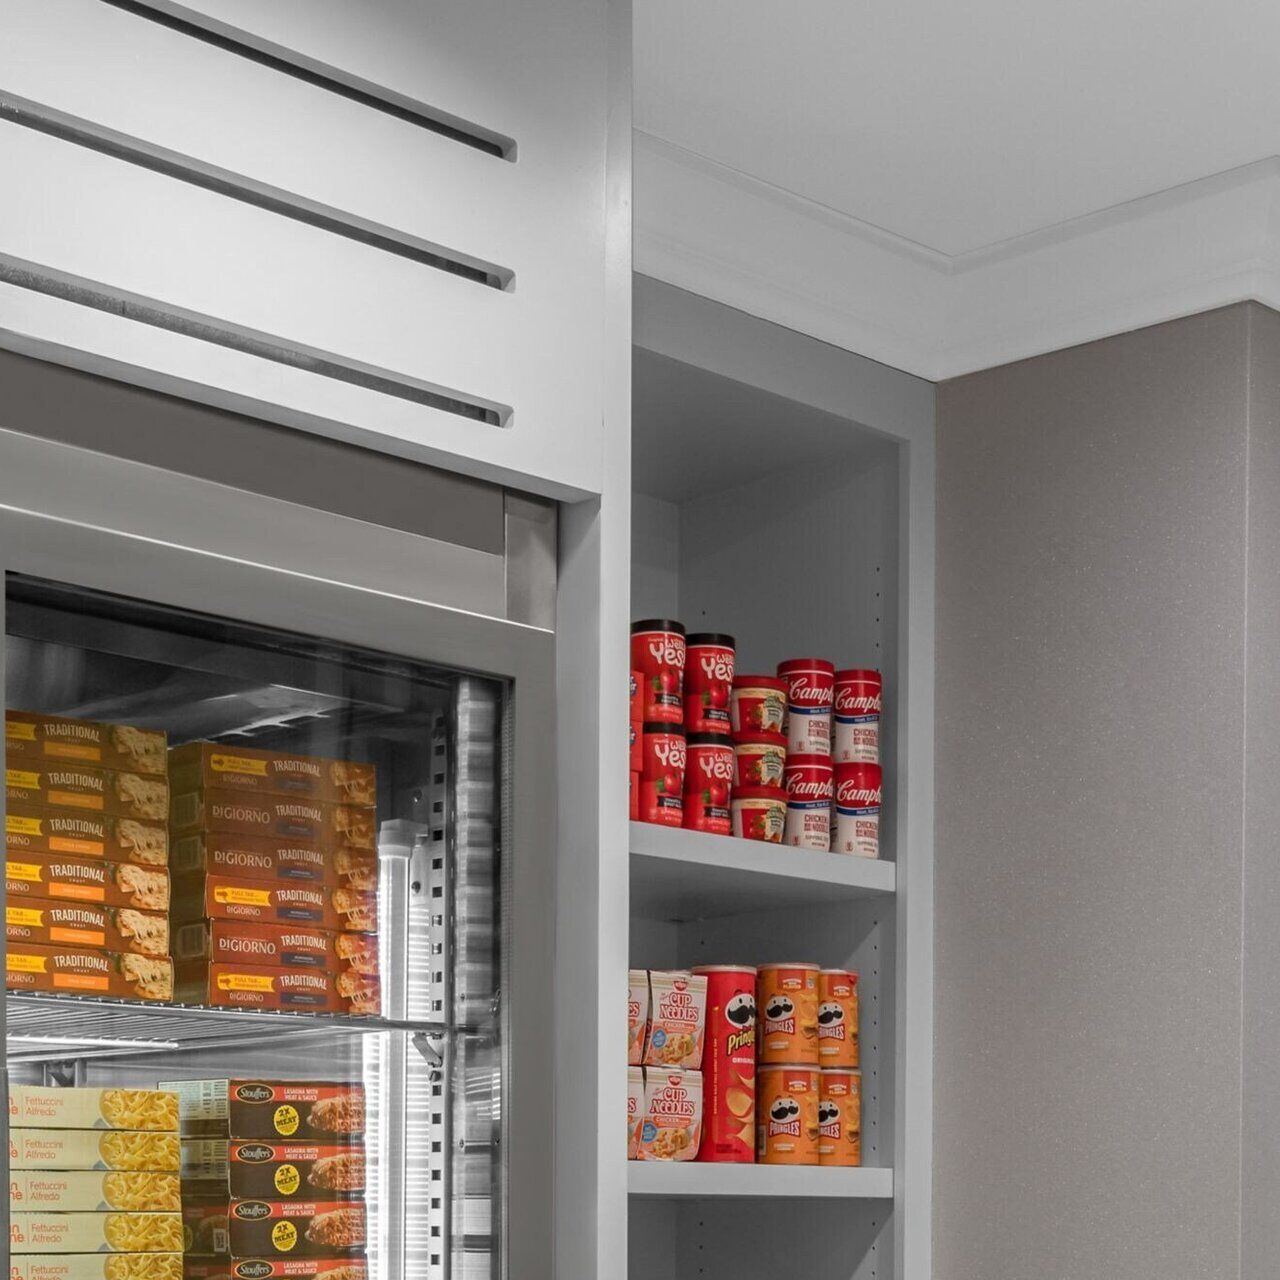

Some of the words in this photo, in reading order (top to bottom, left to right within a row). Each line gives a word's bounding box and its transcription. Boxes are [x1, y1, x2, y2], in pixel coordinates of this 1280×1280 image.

[50, 819, 104, 837] TRADITIONAL
[50, 864, 105, 883] TRADITIONAL
[276, 890, 323, 906] TRADITIONAL
[50, 910, 105, 928] TRADITIONAL
[53, 955, 109, 973] TRADITIONAL
[670, 993, 692, 1008] CUP
[660, 1006, 699, 1022] NOODLES
[766, 1019, 794, 1034] PRINGLES
[25, 1097, 64, 1107] Fettuccini
[25, 1107, 56, 1116] Alfredo
[276, 1117, 297, 1126] MEAT
[770, 1122, 800, 1137] PRINGLES
[25, 1139, 63, 1150] Fettuccini
[25, 1150, 56, 1159] Alfredo
